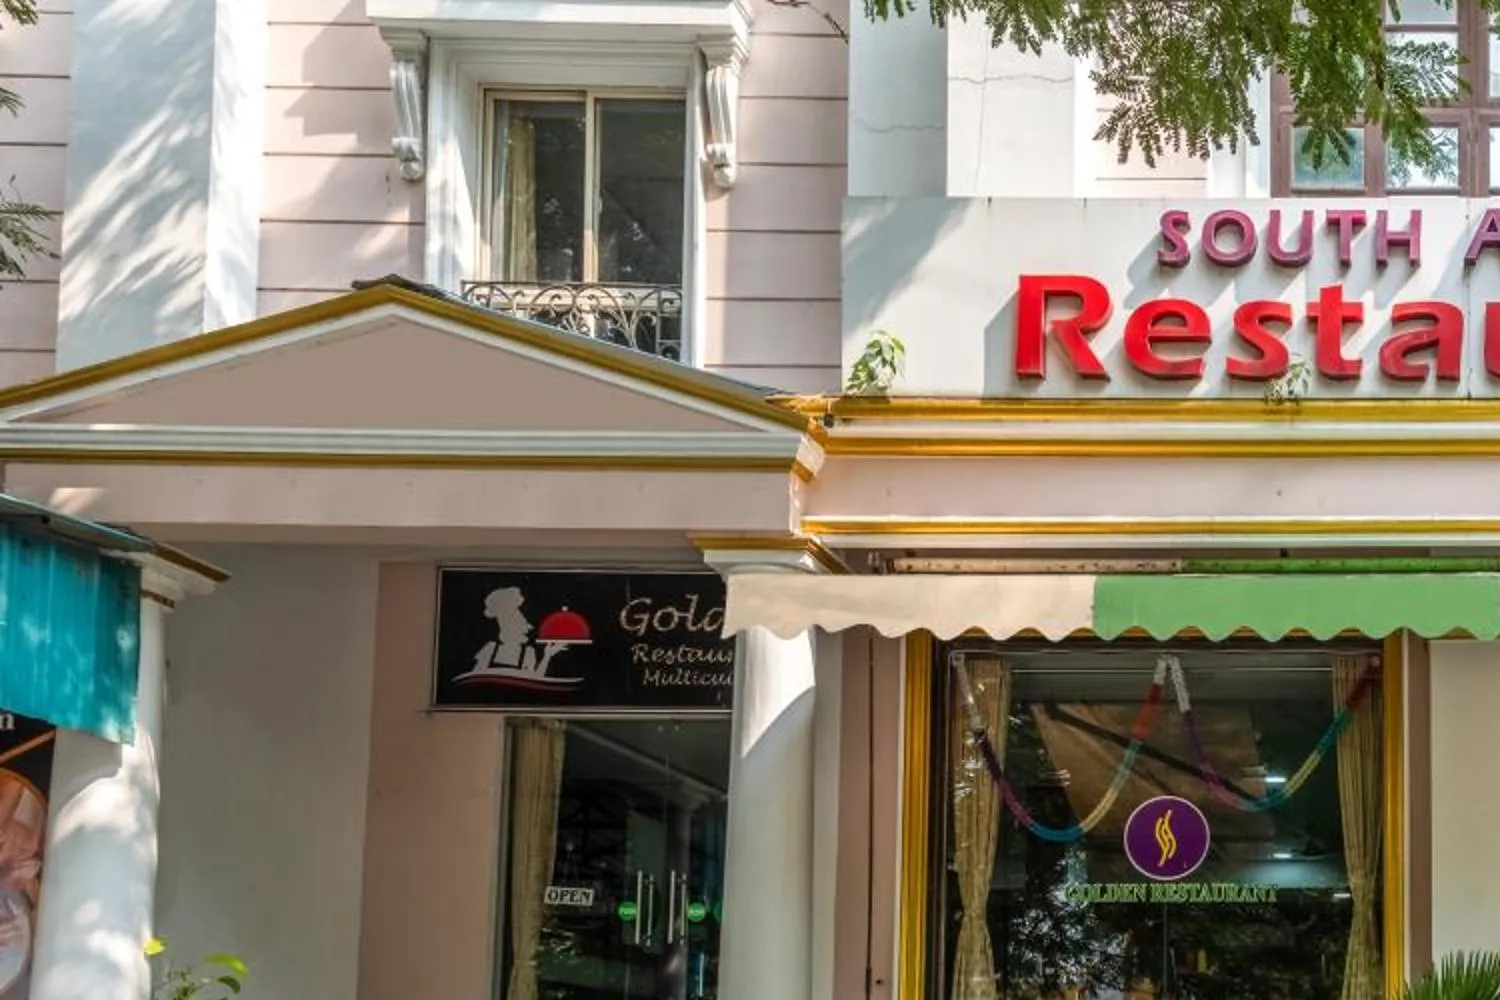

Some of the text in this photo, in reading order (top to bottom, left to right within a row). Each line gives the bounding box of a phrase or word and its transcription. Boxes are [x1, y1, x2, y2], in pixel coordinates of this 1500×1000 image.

[1157, 208, 1422, 268] SOUTH
[547, 889, 591, 903] OPEN
[1065, 883, 1278, 902] GOLDEN RESTAURANT
